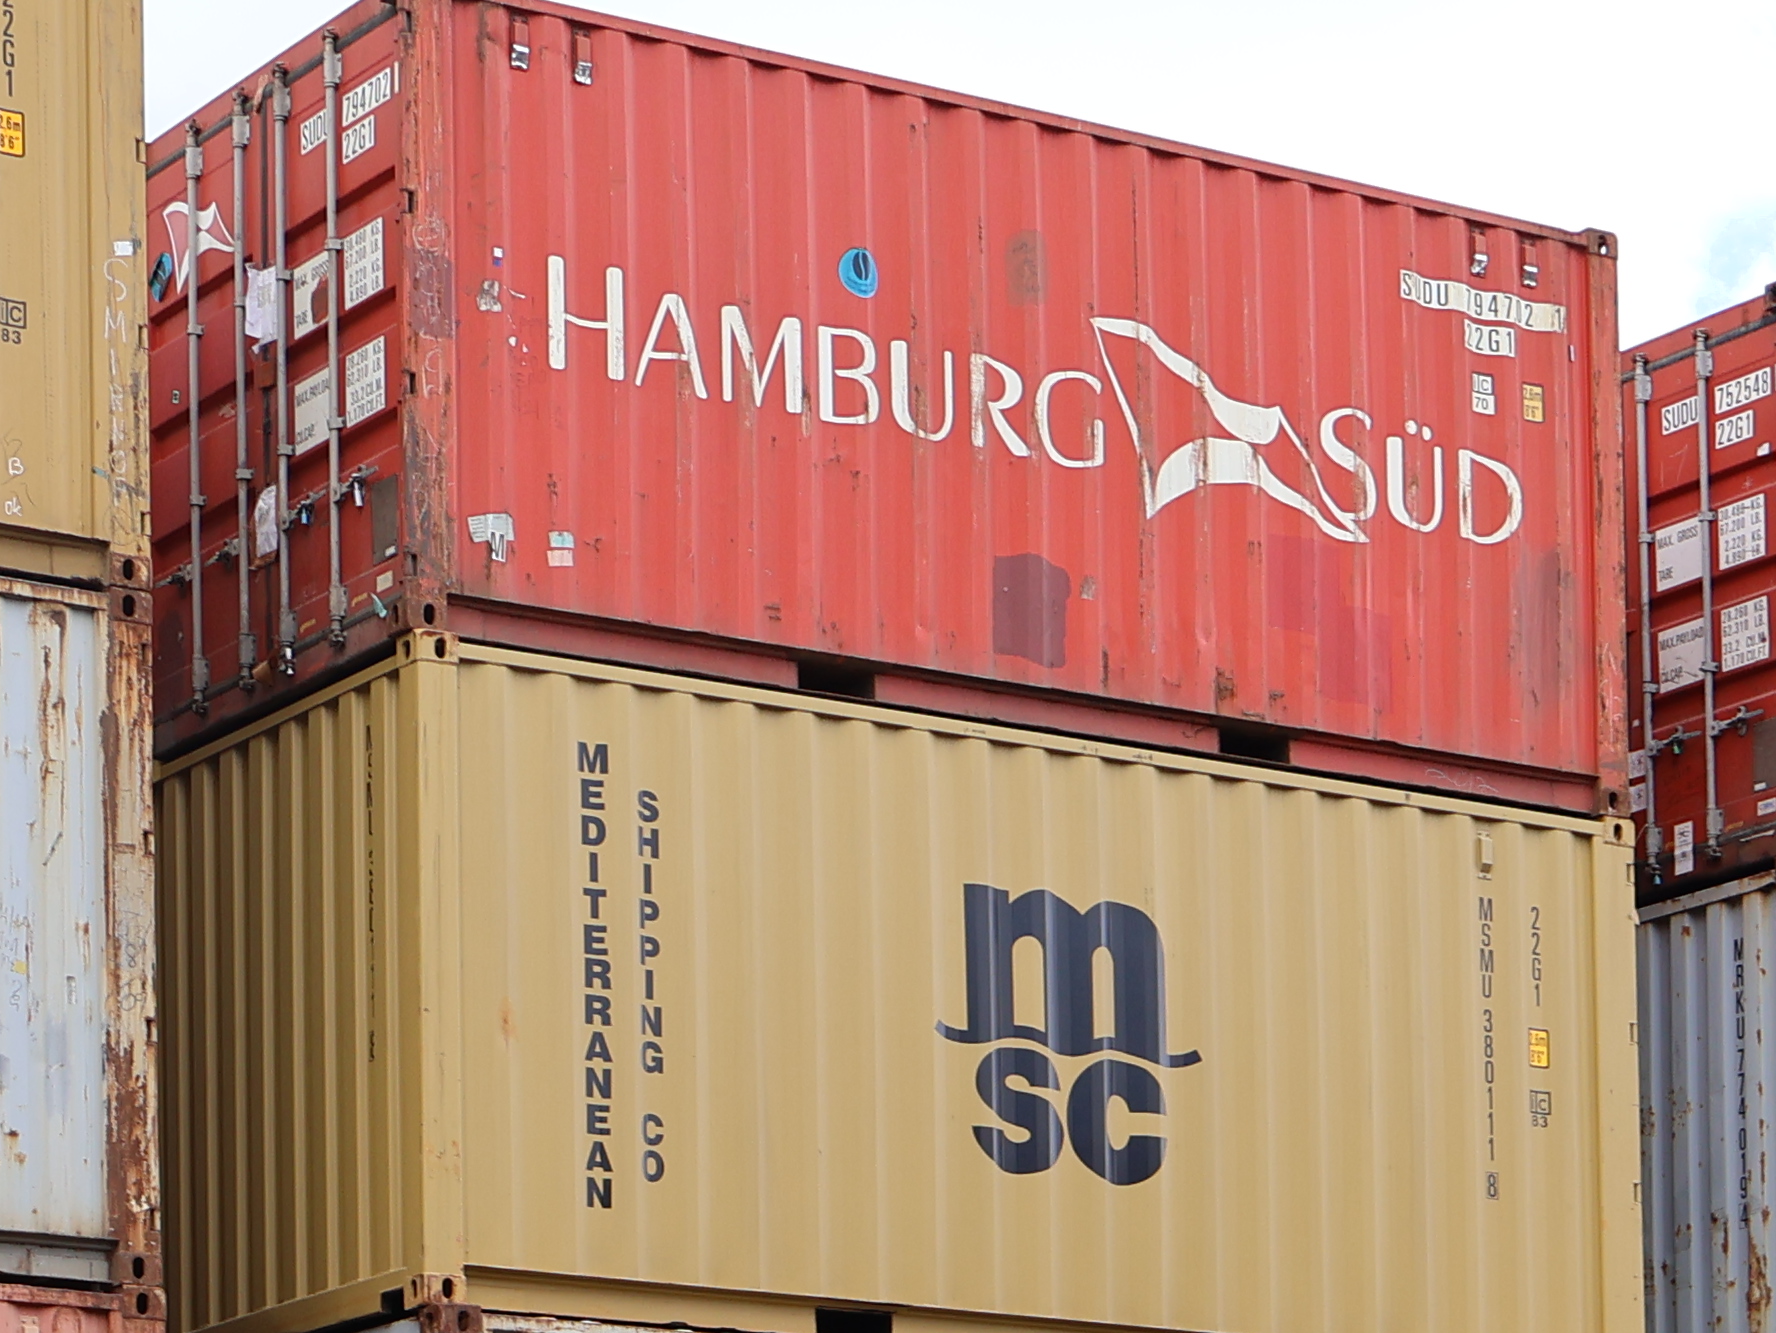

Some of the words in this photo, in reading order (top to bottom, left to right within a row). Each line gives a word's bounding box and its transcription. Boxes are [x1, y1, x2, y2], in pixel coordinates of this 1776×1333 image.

[344, 72, 390, 123] 794702
[343, 118, 373, 160] 22G1
[2, 328, 22, 345] 83
[1466, 287, 1534, 328] 794702
[1466, 322, 1514, 355] 22G1
[546, 253, 1105, 470] HAMBURG
[1663, 396, 1699, 432] SUDU
[1716, 370, 1770, 411] 752548
[1717, 412, 1751, 446] 22G1
[1319, 406, 1523, 546] SÜD
[635, 789, 665, 1076] SHIPPING
[1477, 896, 1495, 999] MSMU
[1529, 905, 1542, 1007] 22G1
[577, 741, 614, 1210] MEDITERRANEAN
[1482, 1008, 1496, 1162] 380111
[640, 1113, 665, 1183] CO
